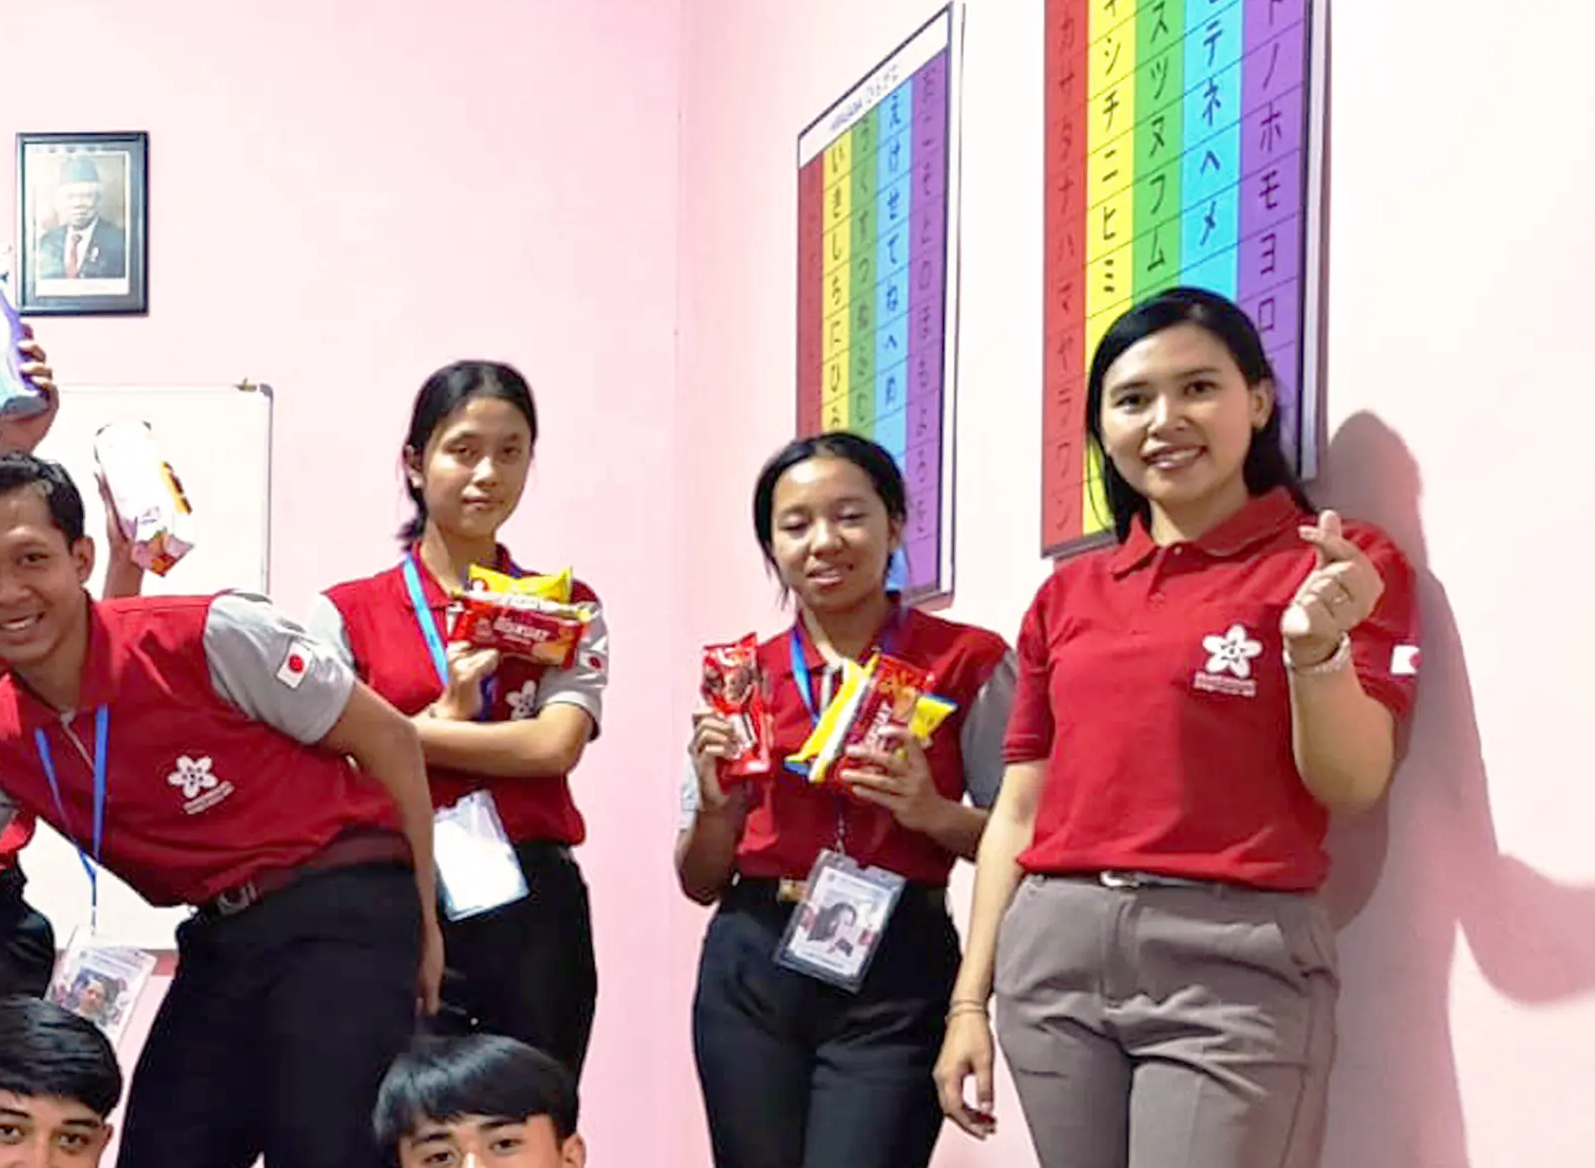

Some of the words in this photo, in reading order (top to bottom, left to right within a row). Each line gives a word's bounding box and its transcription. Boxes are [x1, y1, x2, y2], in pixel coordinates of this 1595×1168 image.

[1102, 90, 1120, 132] チ
[1150, 57, 1169, 101] ツ
[1202, 19, 1224, 67] テ
[1103, 37, 1122, 76] シ
[1150, 0, 1170, 44] ス
[1149, 116, 1166, 158] ヌ
[1202, 76, 1222, 127] ネ
[1102, 205, 1117, 242] ヒ
[1149, 174, 1166, 215] フ
[1259, 101, 1283, 153] ホ
[1102, 258, 1117, 294] ミ
[1147, 226, 1166, 273] ム
[1199, 200, 1218, 248] メ
[1258, 170, 1282, 211] モ
[1259, 232, 1277, 276] ヨ
